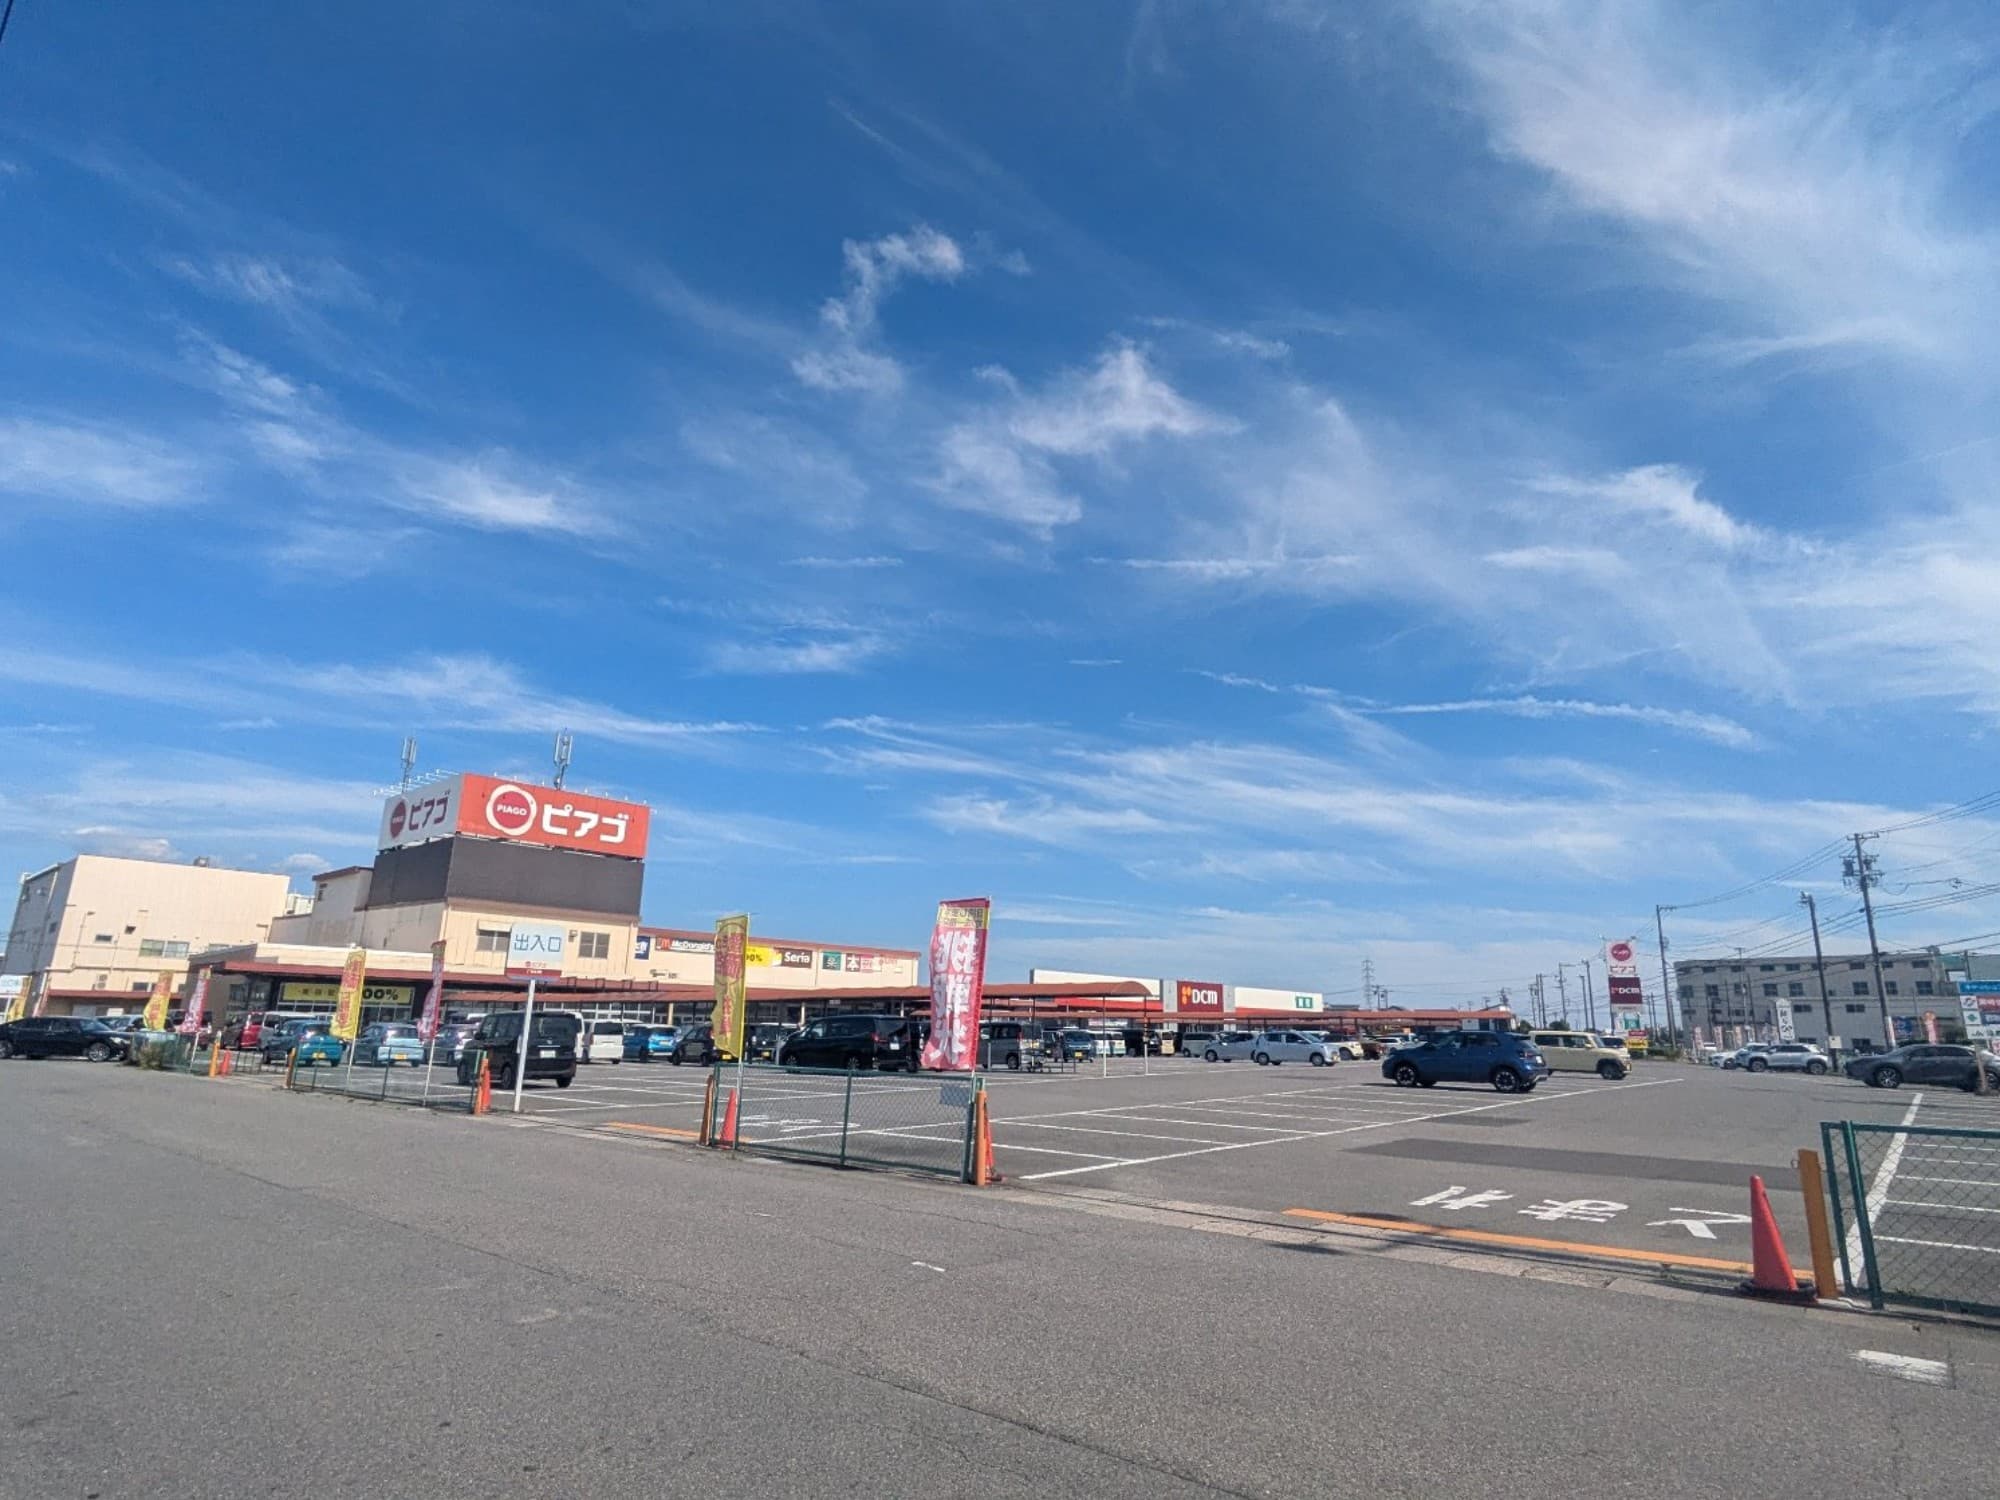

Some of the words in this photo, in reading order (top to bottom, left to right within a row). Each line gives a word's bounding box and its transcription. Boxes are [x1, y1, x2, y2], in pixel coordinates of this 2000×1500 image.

[408, 791, 450, 831] ピアゴ
[496, 804, 528, 816] PIAGO
[541, 803, 630, 844] ピアゴ
[513, 934, 562, 953] 出入口
[784, 952, 811, 964] Seria
[847, 954, 860, 971] 本
[1192, 988, 1218, 1005] DCM
